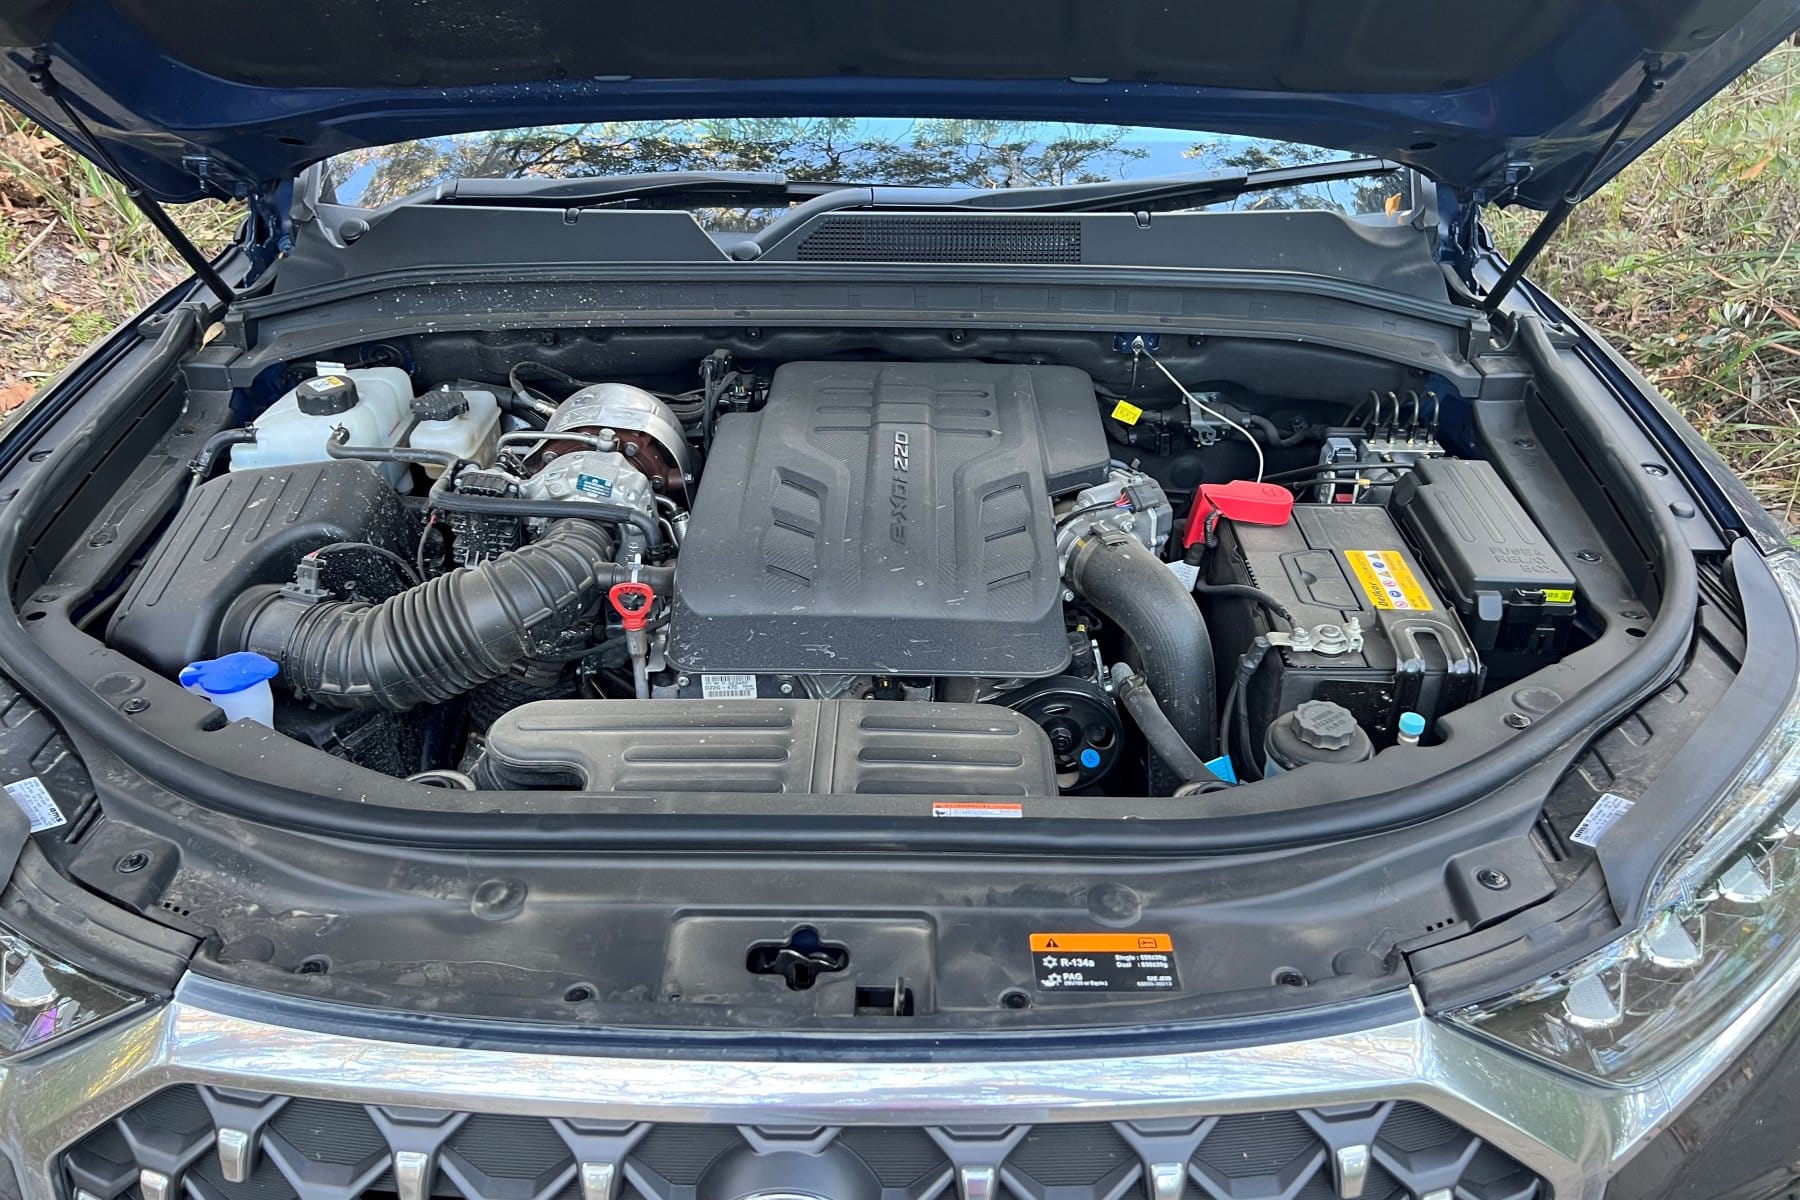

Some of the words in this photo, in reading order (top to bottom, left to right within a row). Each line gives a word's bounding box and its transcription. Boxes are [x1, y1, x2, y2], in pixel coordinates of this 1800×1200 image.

[894, 431, 909, 473] 220
[1494, 555, 1548, 565] RELAY
[1520, 564, 1559, 574] BOX
[1060, 958, 1095, 968] R-134a
[1063, 973, 1083, 981] PAG
